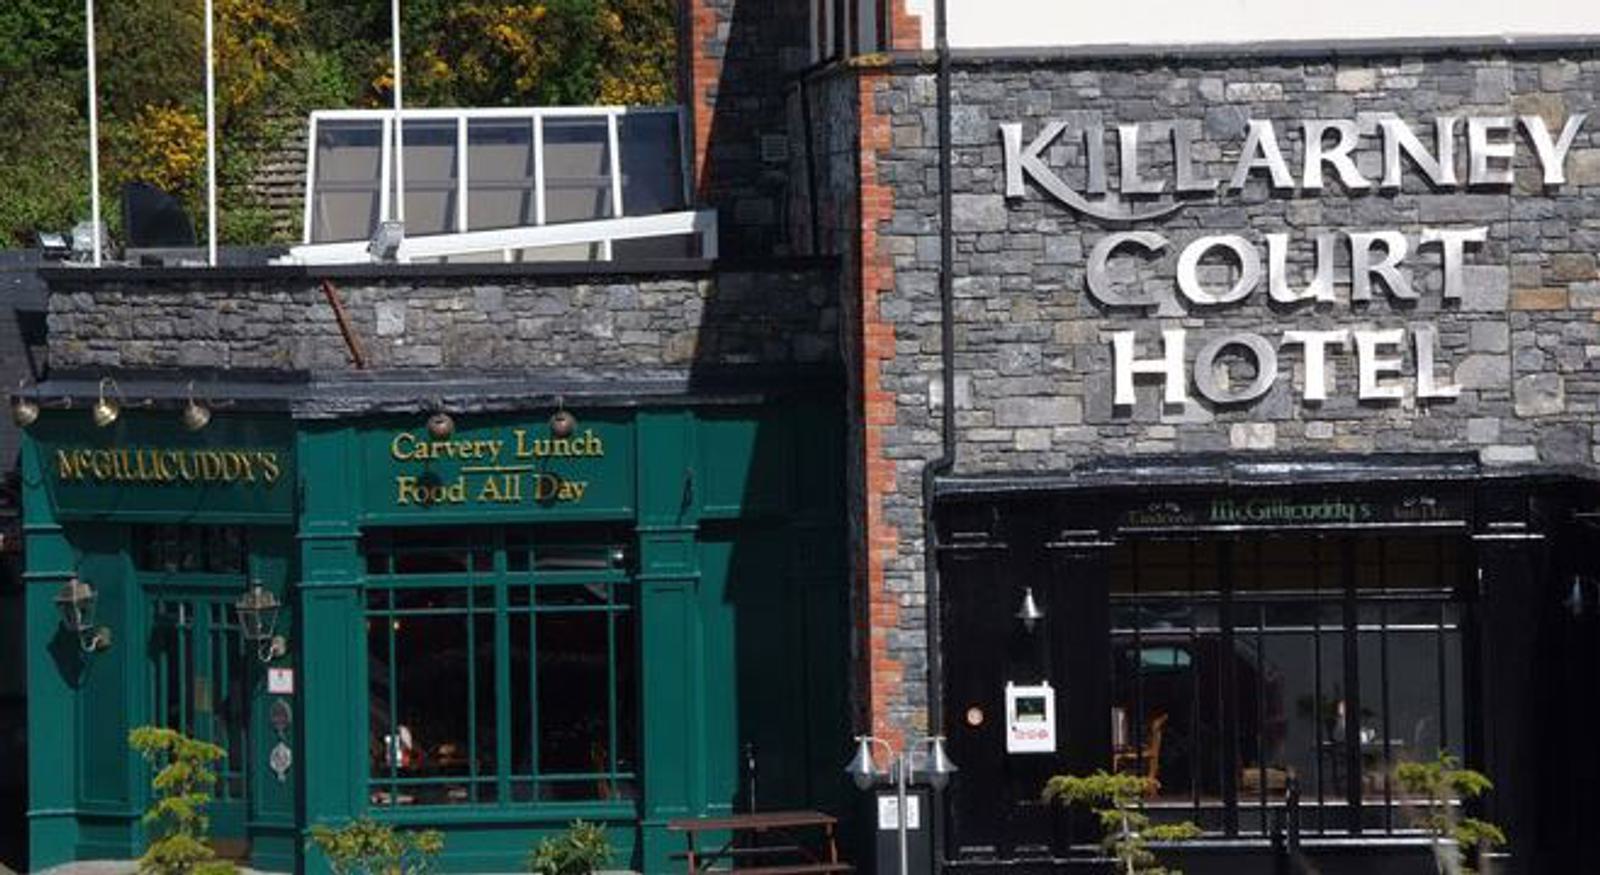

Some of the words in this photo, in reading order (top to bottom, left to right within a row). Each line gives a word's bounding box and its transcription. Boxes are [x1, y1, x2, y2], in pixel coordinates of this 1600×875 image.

[999, 113, 1588, 221] KILLARNEY
[1085, 226, 1488, 307] COURT
[1111, 328, 1464, 405] HOTEL
[392, 432, 504, 463] Carvery
[513, 429, 604, 459] Lunch
[396, 475, 465, 504] Food
[478, 473, 522, 501] All
[533, 473, 588, 504] Day
